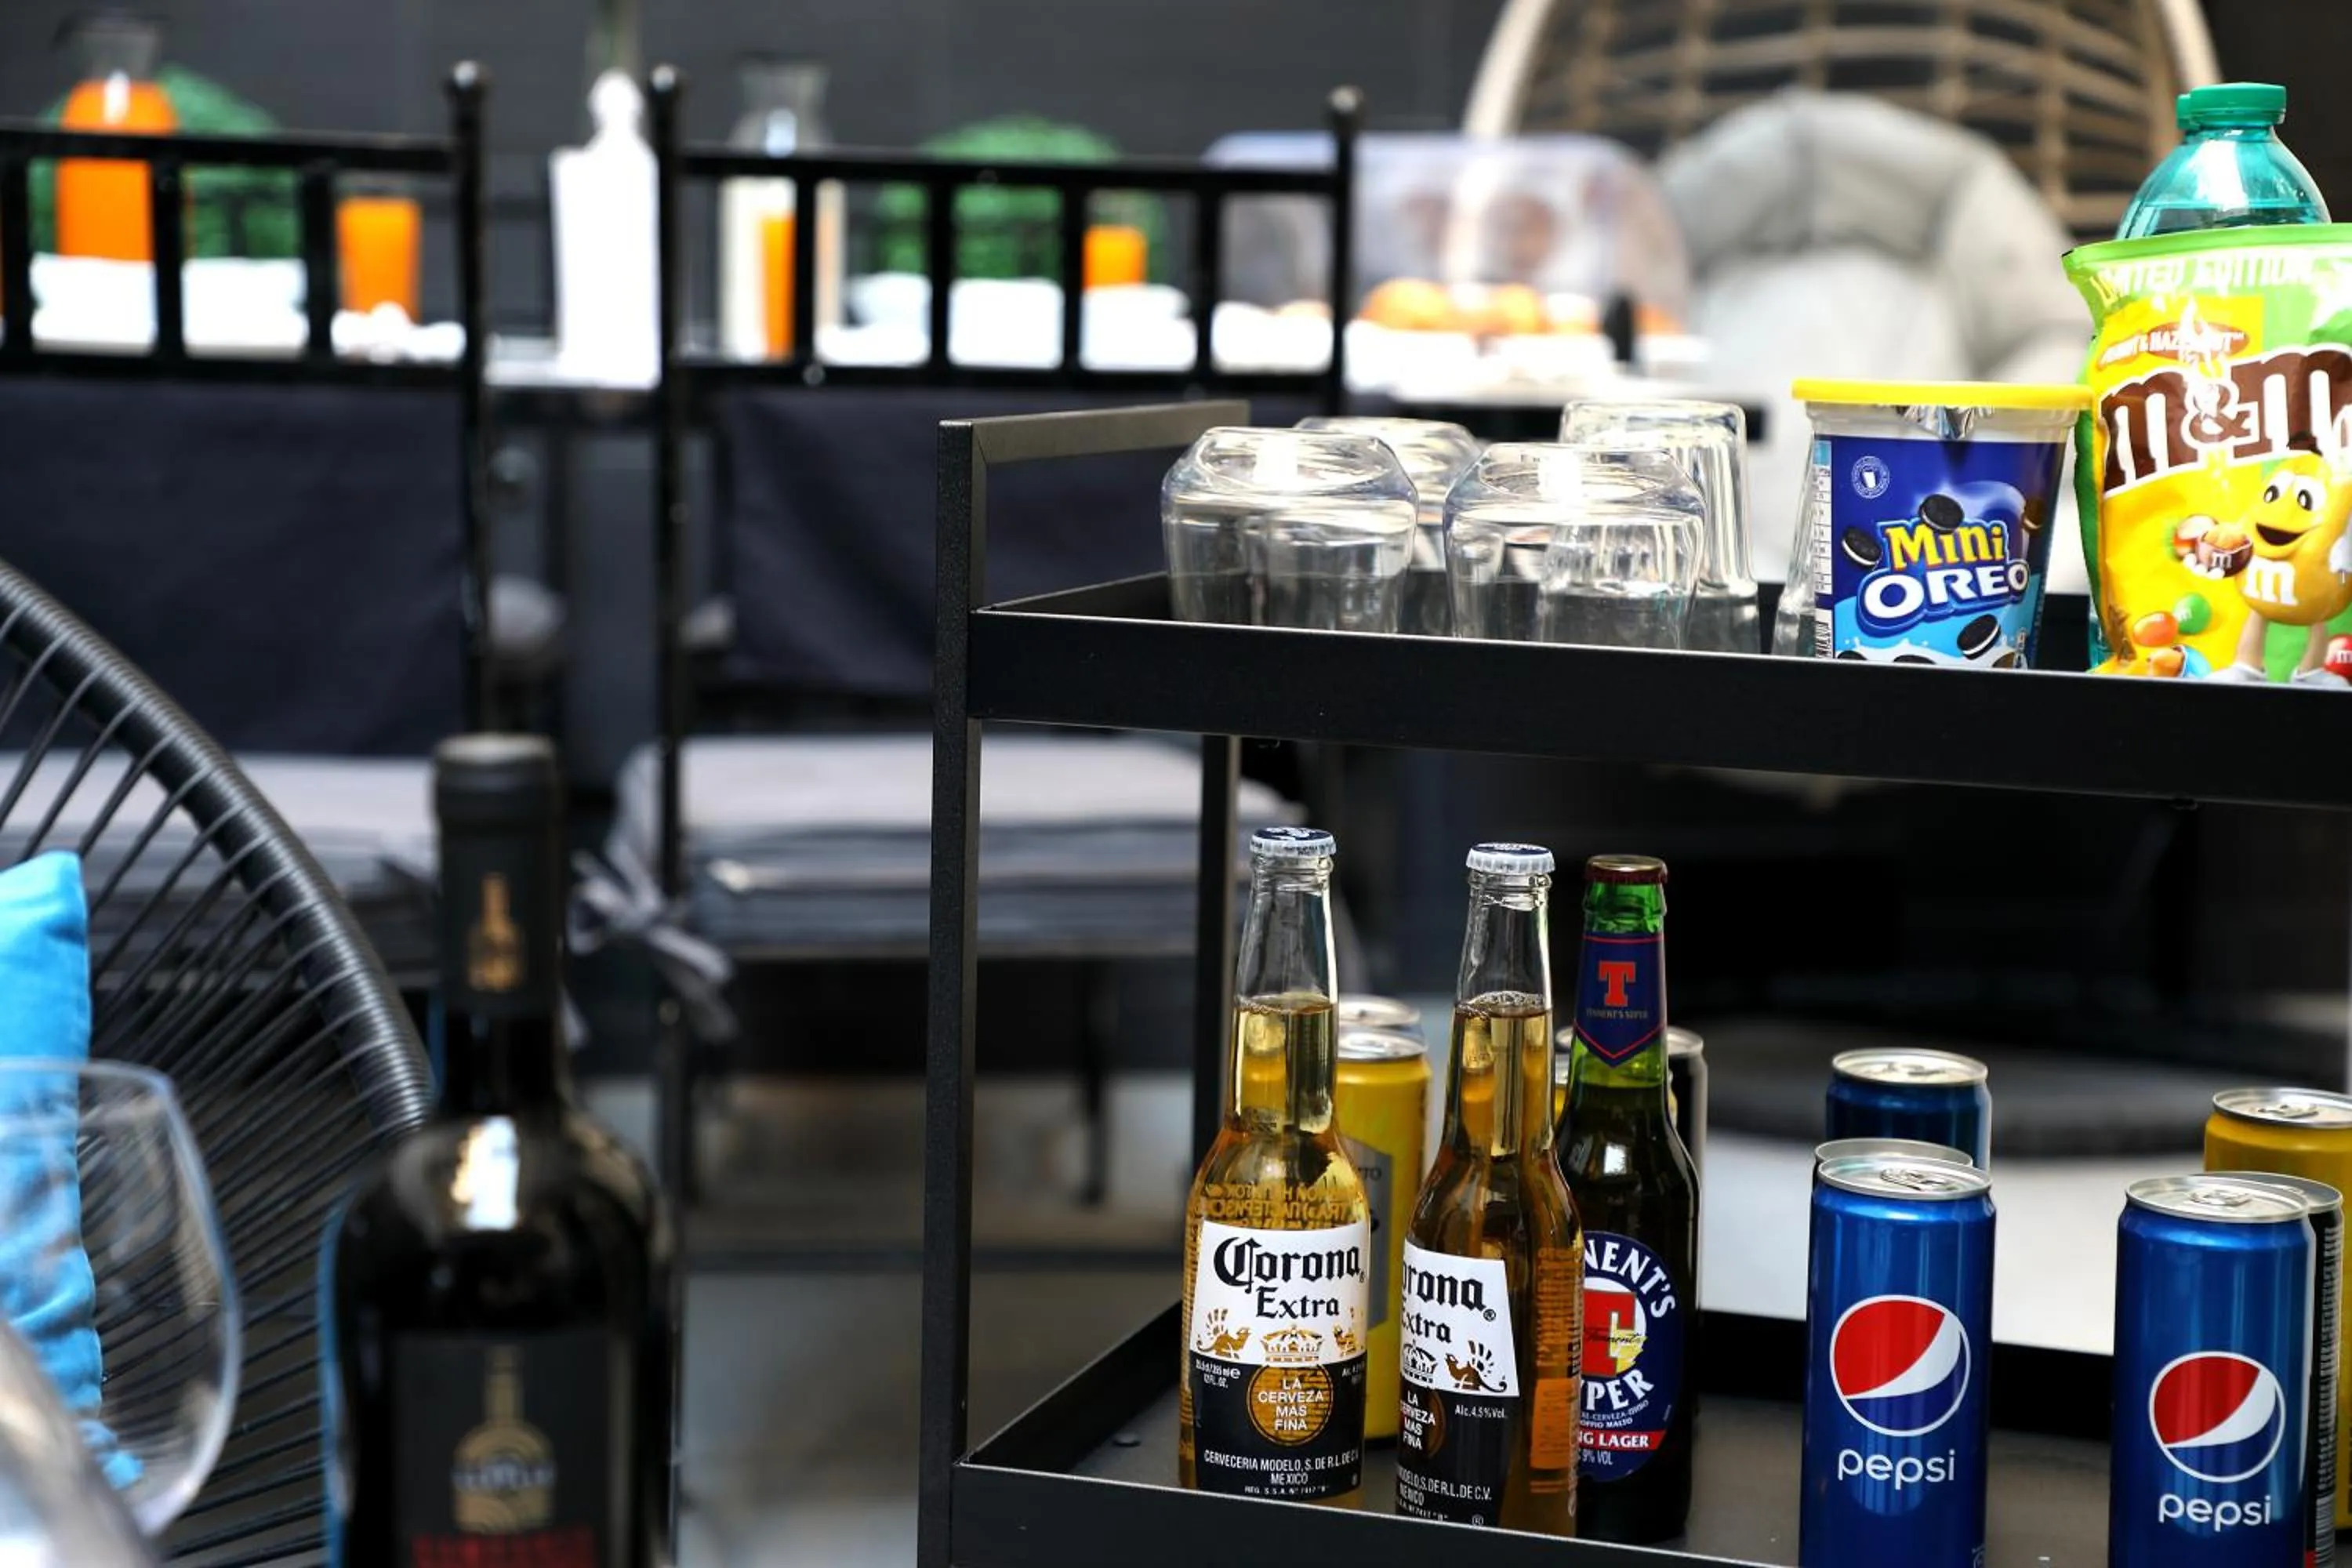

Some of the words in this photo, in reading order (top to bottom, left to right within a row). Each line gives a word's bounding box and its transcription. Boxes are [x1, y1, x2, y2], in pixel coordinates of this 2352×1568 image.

[1886, 521, 2006, 571] Mini
[1864, 564, 2029, 619] OREO
[2242, 555, 2299, 606] m
[1599, 961, 1636, 1007] T
[1214, 1237, 1360, 1294] Corona
[1256, 1286, 1339, 1319] Extra
[1402, 1261, 1486, 1312] orona
[1402, 1307, 1452, 1343] xtra
[1258, 1390, 1325, 1403] CERVEZA
[1282, 1379, 1302, 1391] LA
[1407, 1391, 1418, 1406] LA
[1580, 1369, 1654, 1410] PER
[1274, 1418, 1308, 1431] FINA
[1276, 1405, 1308, 1417] MAS
[1404, 1417, 1423, 1436] MAS
[1403, 1431, 1423, 1450] FINA
[1599, 1433, 1650, 1449] LAGER
[1204, 1450, 1258, 1471] CERVECERIA
[1315, 1457, 1326, 1470] DE
[1838, 1448, 1955, 1490] pepsi
[1270, 1472, 1308, 1485] MEXICO
[2158, 1493, 2271, 1532] pepsi
